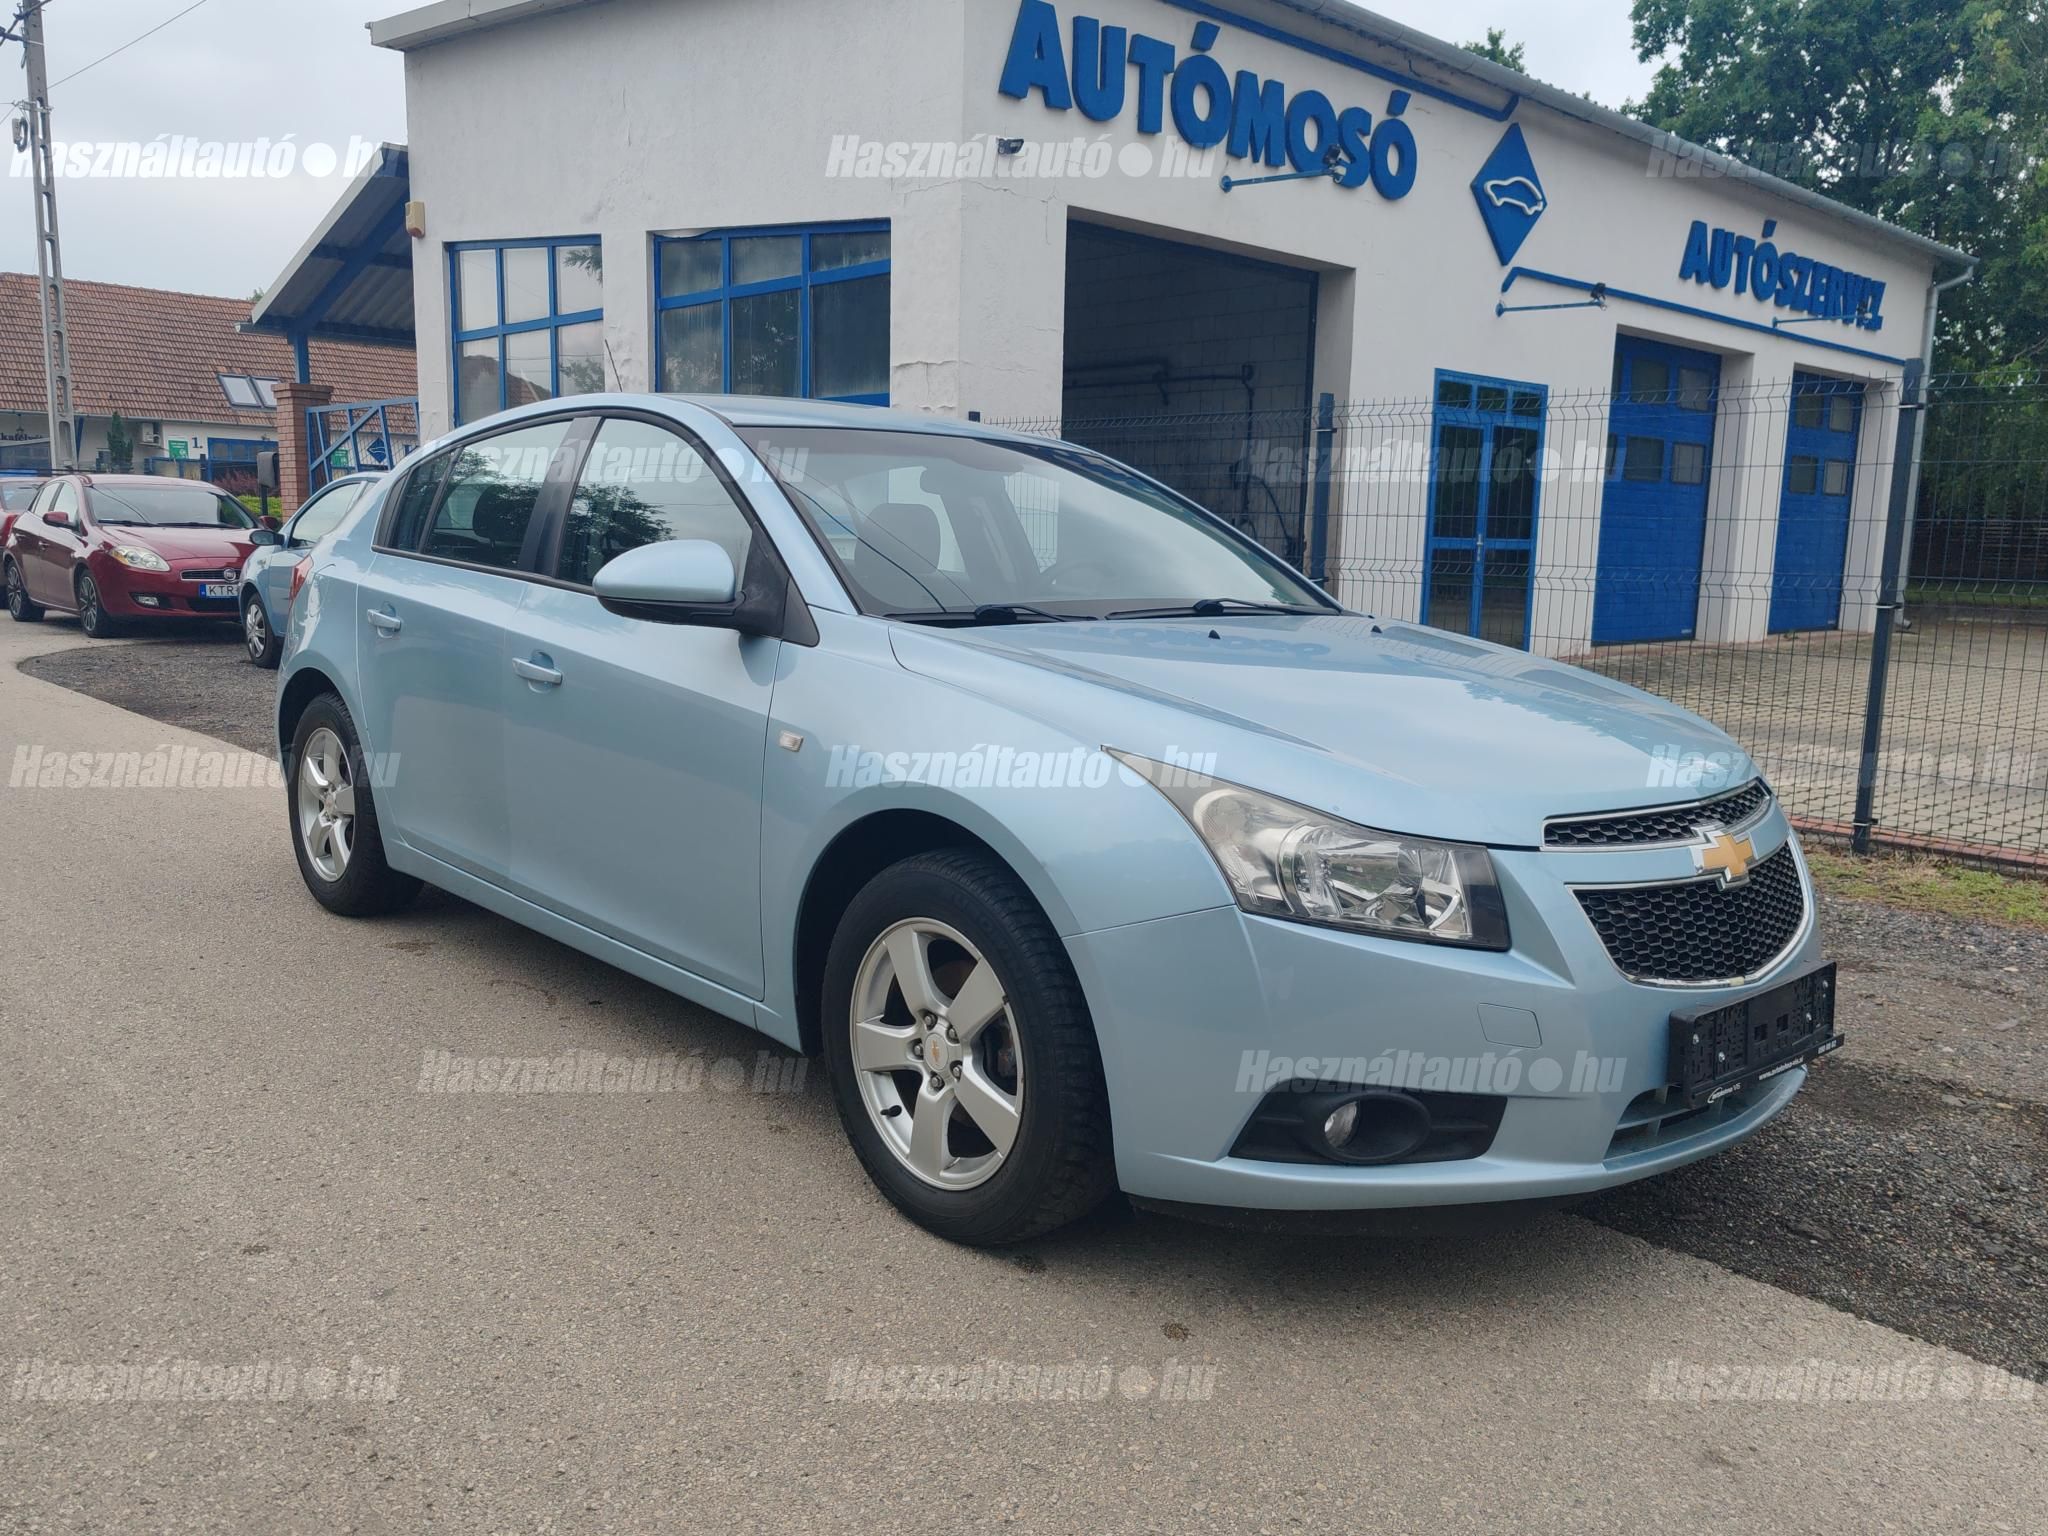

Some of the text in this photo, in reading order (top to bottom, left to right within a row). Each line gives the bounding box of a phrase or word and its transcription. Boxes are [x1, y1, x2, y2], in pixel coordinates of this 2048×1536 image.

[1000, 0, 1418, 201] AUTÓMOSÓ
[1680, 219, 1887, 331] AUTÓSZERVIZ
[208, 585, 240, 596] KTR-
